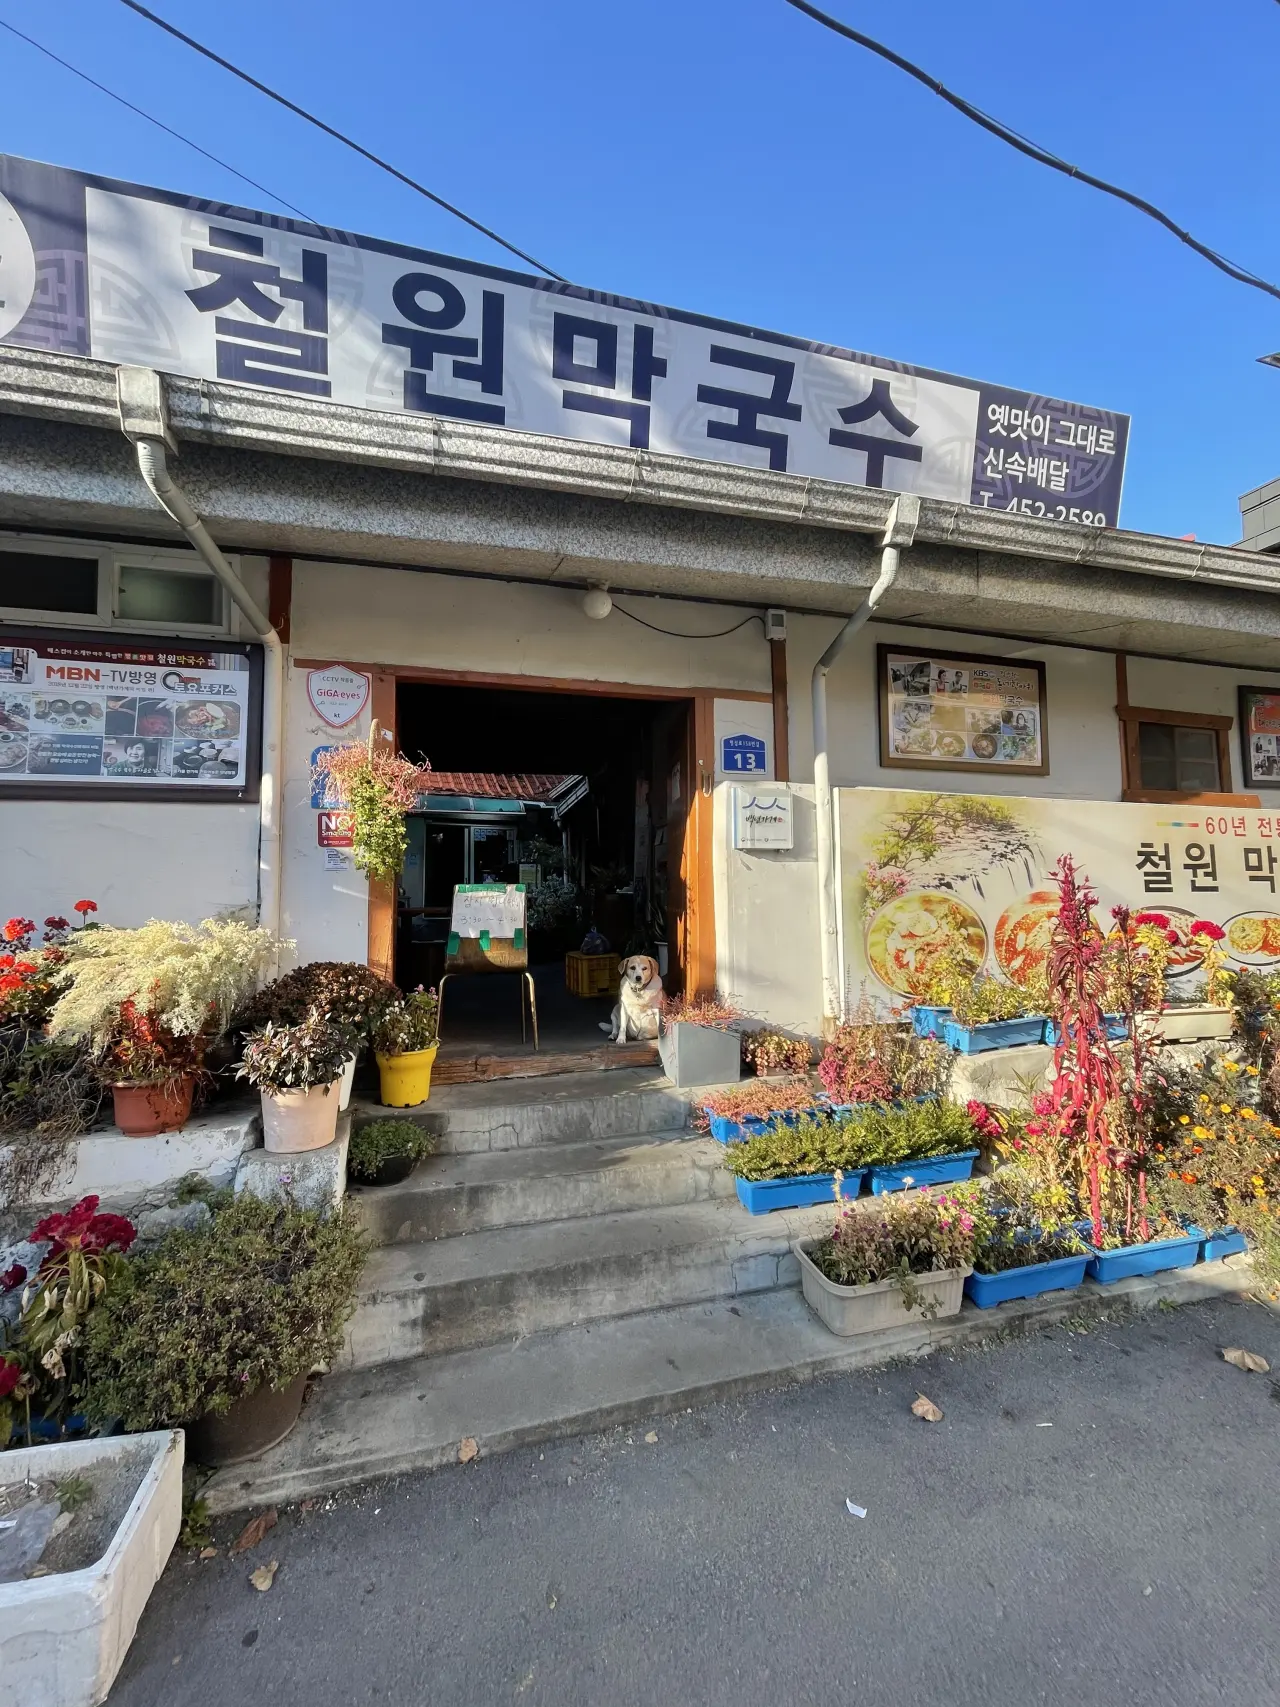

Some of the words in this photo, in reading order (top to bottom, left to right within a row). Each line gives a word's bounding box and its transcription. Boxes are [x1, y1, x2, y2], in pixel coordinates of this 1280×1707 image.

[185, 226, 923, 488] 철원막국수
[987, 403, 1051, 446] 옛맛이
[1055, 420, 1116, 456] 그대로
[983, 447, 1070, 492] 신속배달
[157, 653, 206, 666] 철원막국수
[973, 669, 989, 678] KBS
[174, 682, 237, 696] 토요포커스
[733, 753, 756, 769] 13
[321, 815, 351, 830] NO
[1205, 816, 1247, 837] 60년
[321, 829, 352, 837] Smoing
[1135, 842, 1220, 893] 철원
[1243, 845, 1278, 894] 막
